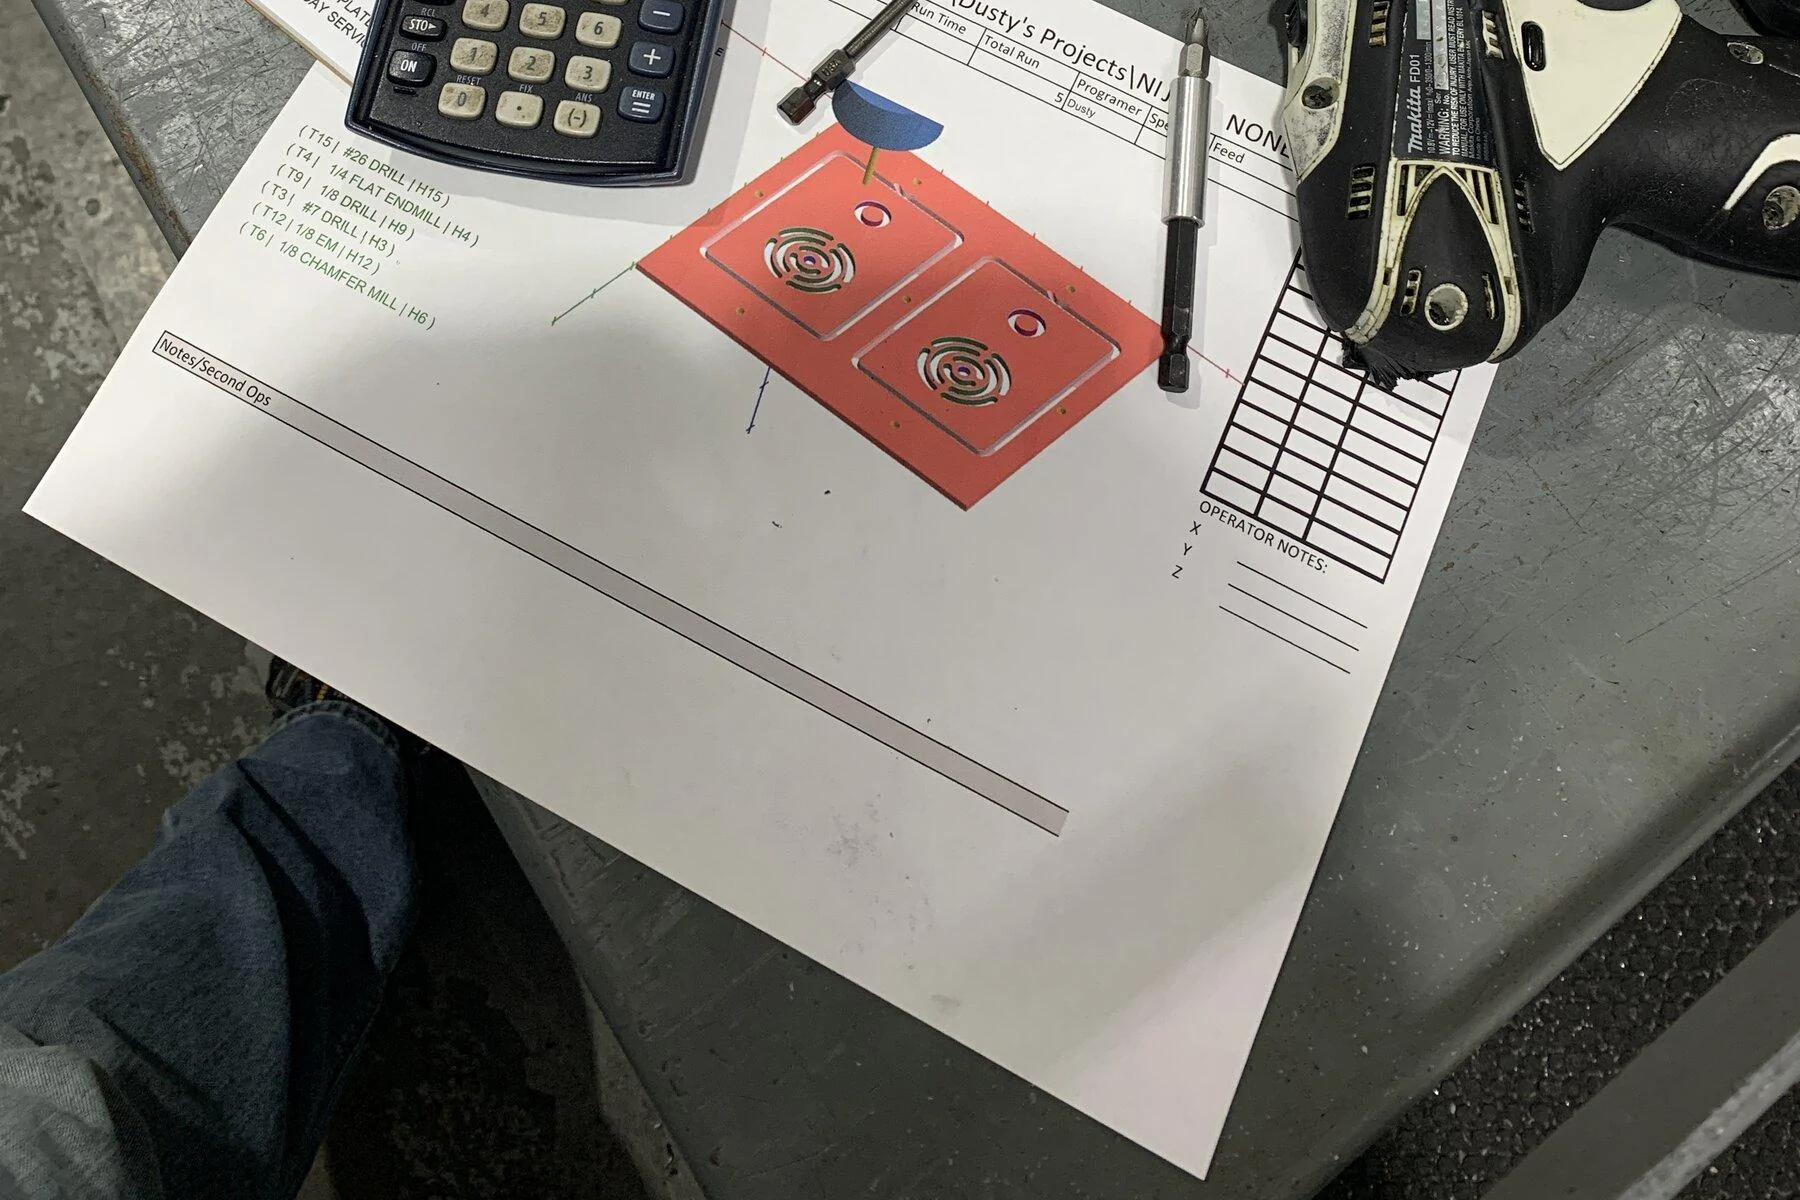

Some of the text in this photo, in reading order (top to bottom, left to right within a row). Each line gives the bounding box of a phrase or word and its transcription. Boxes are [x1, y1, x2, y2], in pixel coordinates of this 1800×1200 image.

[421, 8, 436, 17] RCL
[480, 3, 491, 18] 4
[911, 1, 967, 34] Run Time
[537, 11, 548, 26] 5
[1447, 17, 1455, 31] READ
[594, 21, 603, 35] 6
[411, 42, 427, 52] OFF
[984, 34, 1040, 69] Total Run
[470, 47, 478, 64] 1
[525, 55, 537, 71] 2
[401, 59, 418, 73] ON
[582, 66, 593, 80] 3
[456, 75, 482, 85] RESET
[519, 84, 534, 93] FIX
[632, 89, 656, 101] ENTER
[1450, 87, 1458, 96] OF
[458, 91, 467, 106] 0
[576, 93, 593, 102] ANS
[1054, 92, 1064, 103] 5
[1076, 79, 1143, 116] Programer
[1407, 54, 1422, 153] Makita FD01
[1450, 97, 1458, 110] RISK
[1458, 89, 1466, 104] ONLY
[1067, 98, 1096, 119] Dusty
[1148, 112, 1169, 131] Spe
[1438, 108, 1450, 154] WARNING:
[1213, 142, 1245, 163] Feed
[343, 147, 369, 165] #26
[368, 158, 405, 186] DRILL
[320, 185, 339, 201] 1/8
[340, 195, 377, 222] DRILL
[330, 164, 349, 181] 1/4
[348, 174, 385, 198] FLAT
[384, 191, 441, 229] ENDMILL
[302, 201, 321, 216] #7
[320, 210, 357, 238] DRILL
[296, 223, 315, 240] 1/8
[315, 233, 339, 252] EM
[280, 241, 299, 258] 1/8
[300, 252, 367, 293] CHAMFER
[367, 286, 397, 310] MILL
[159, 338, 272, 406] Notes/Second Ops
[1189, 520, 1202, 535] X
[1199, 500, 1328, 574] OPERATOR NOTES:
[1182, 542, 1193, 556] Y
[1171, 565, 1183, 579] Z
